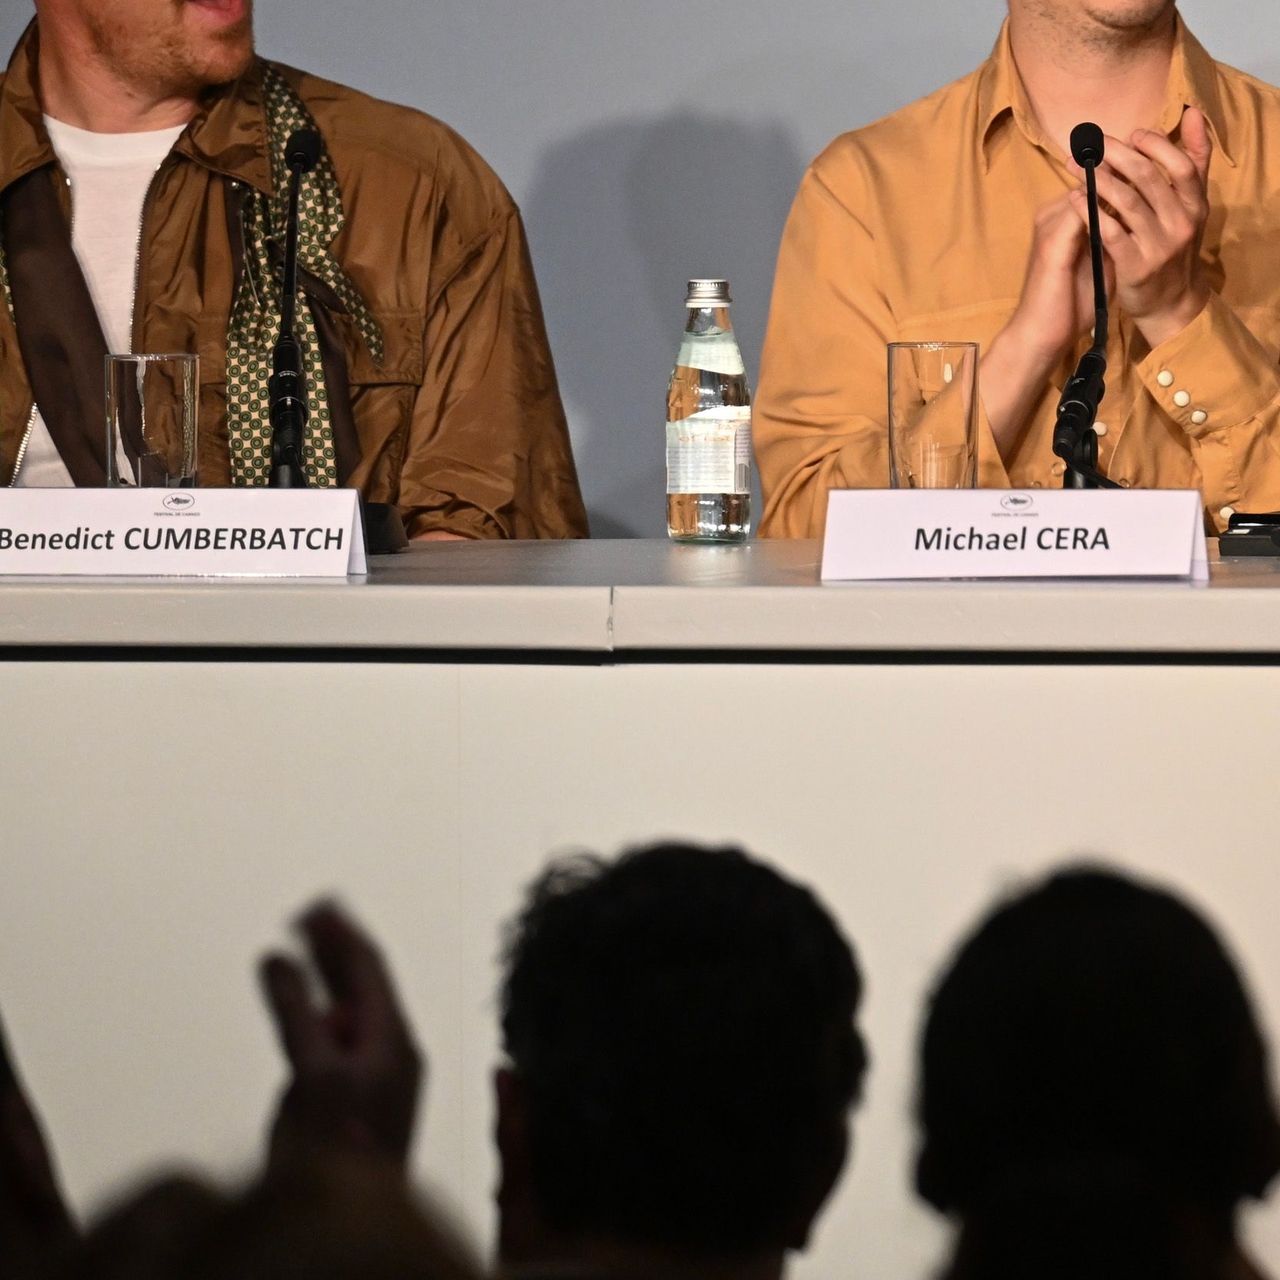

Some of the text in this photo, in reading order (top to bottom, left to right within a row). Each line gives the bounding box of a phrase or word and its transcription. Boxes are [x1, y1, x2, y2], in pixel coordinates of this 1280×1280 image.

[0, 526, 344, 551] Benedict CUMBERBATCH
[914, 526, 1111, 551] Michael CERA
